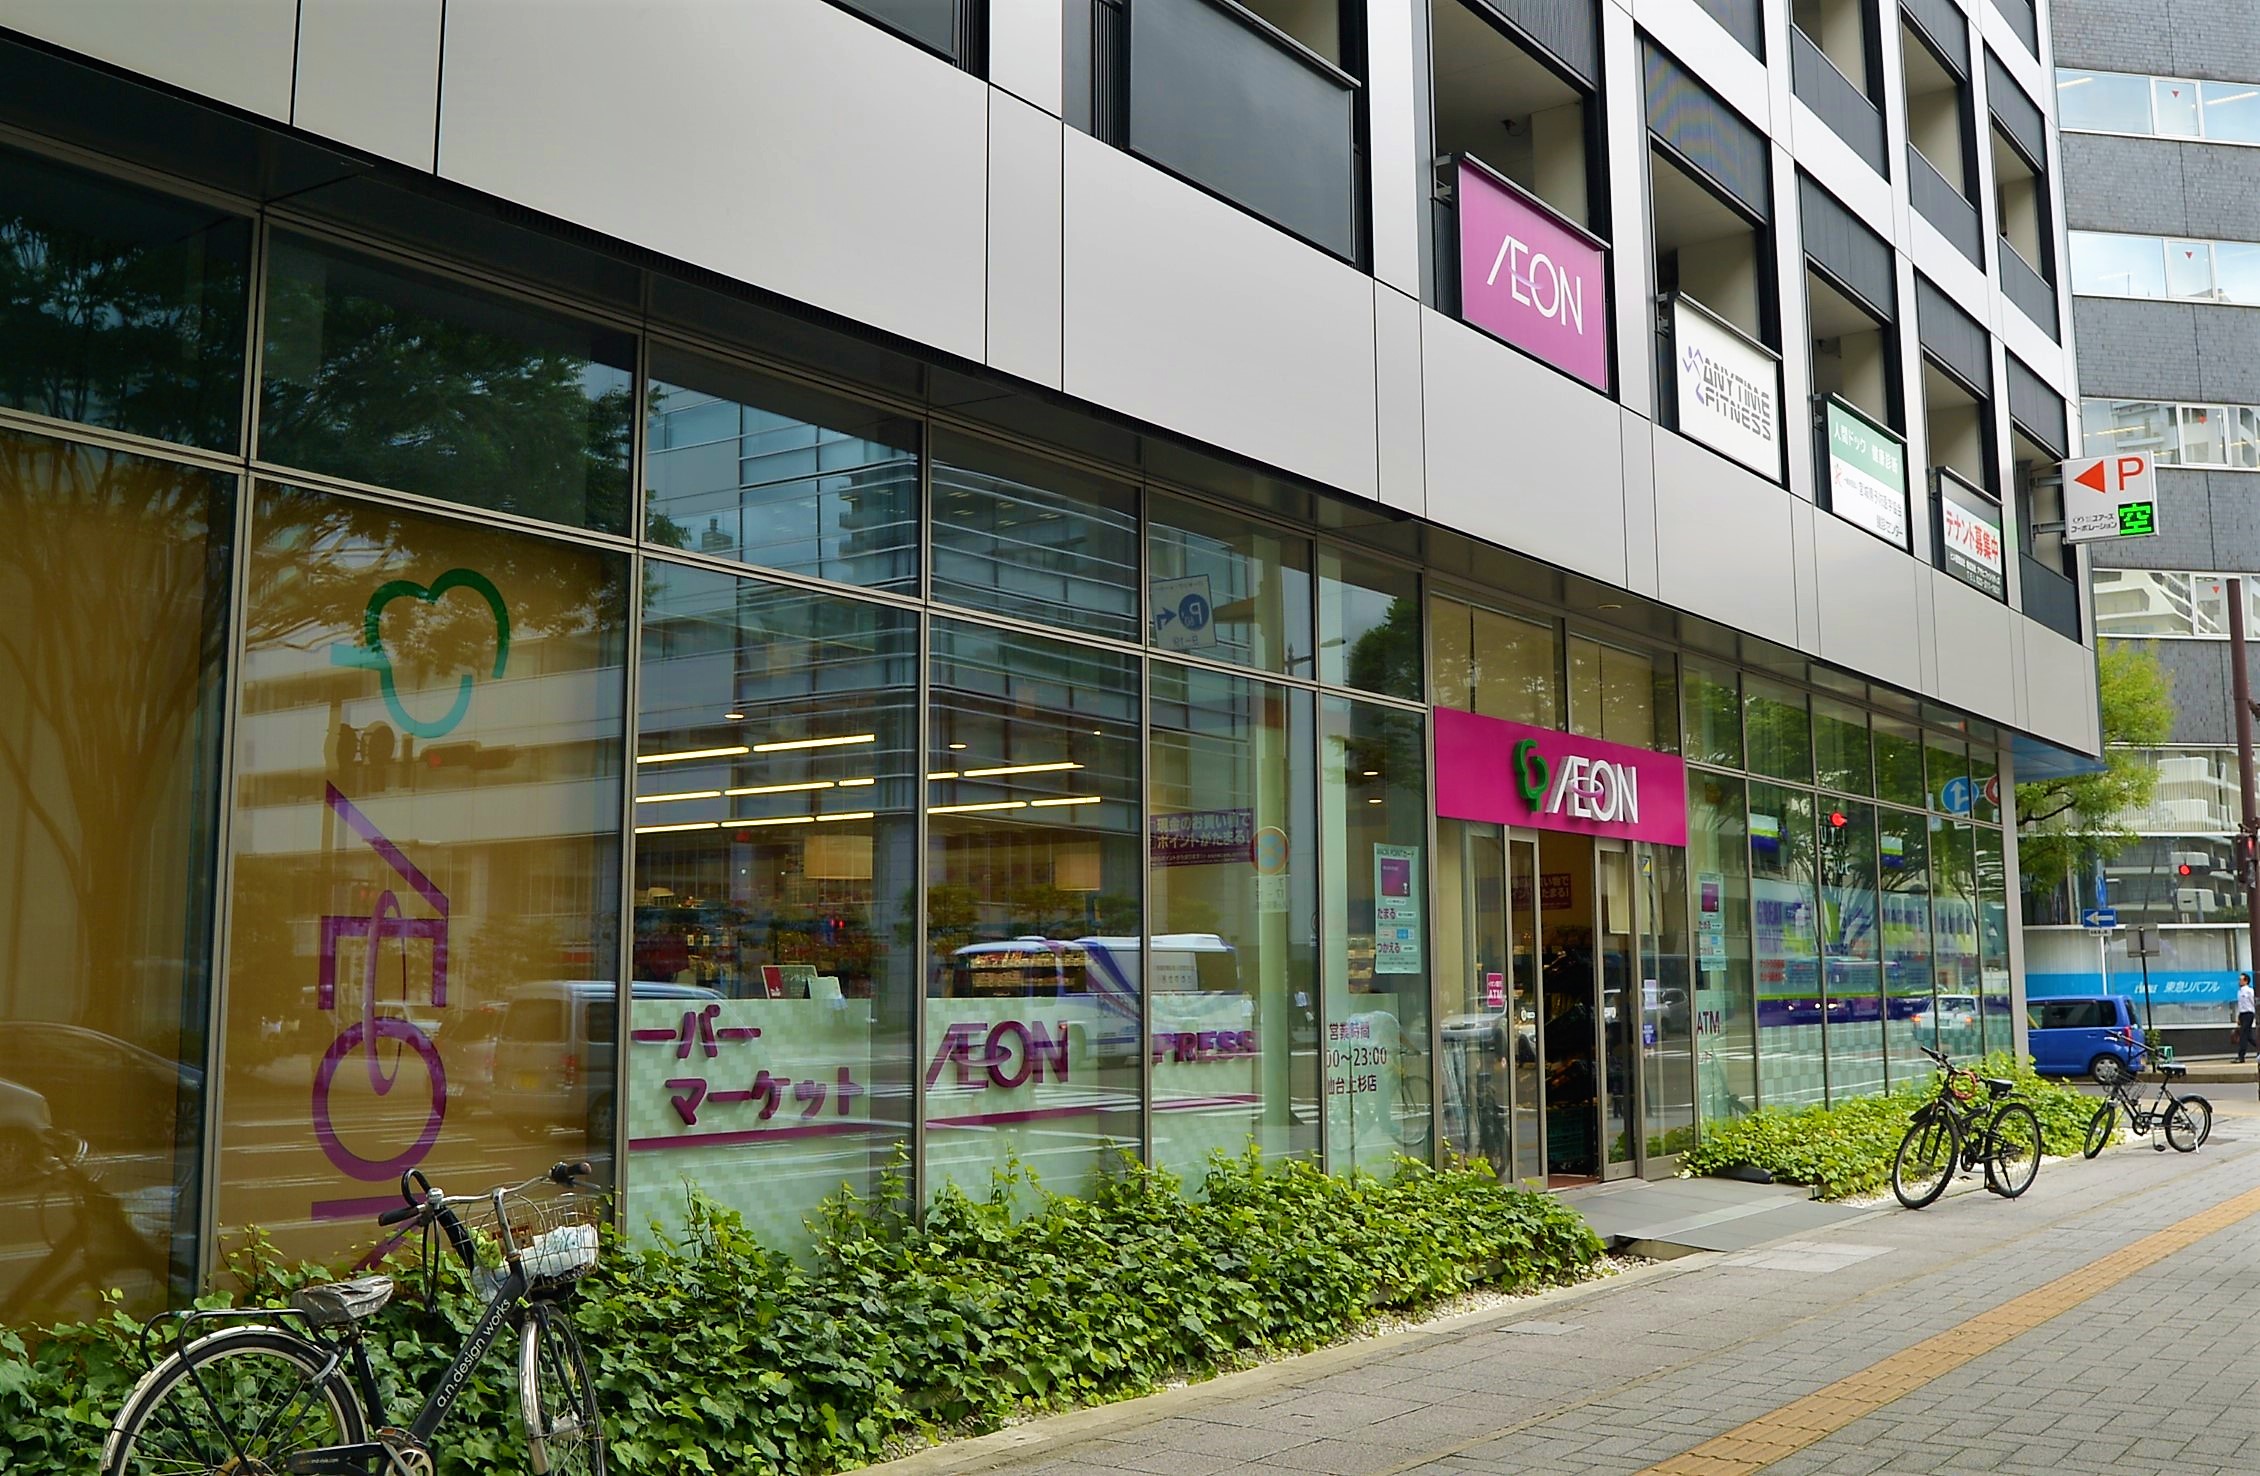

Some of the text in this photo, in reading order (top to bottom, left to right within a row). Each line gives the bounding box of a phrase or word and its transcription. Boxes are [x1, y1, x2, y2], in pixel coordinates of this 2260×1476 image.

[1703, 357, 1770, 418] ANYTIME
[1705, 386, 1772, 441] FITNESS
[2117, 457, 2144, 491] P
[1946, 510, 1998, 564] テナント募集中
[2119, 503, 2152, 530] 空
[1330, 1022, 1370, 1040] 営業時間
[1697, 1011, 1720, 1035] ATM
[665, 1066, 865, 1126] マーケット
[437, 1299, 511, 1408] a.n.design works
